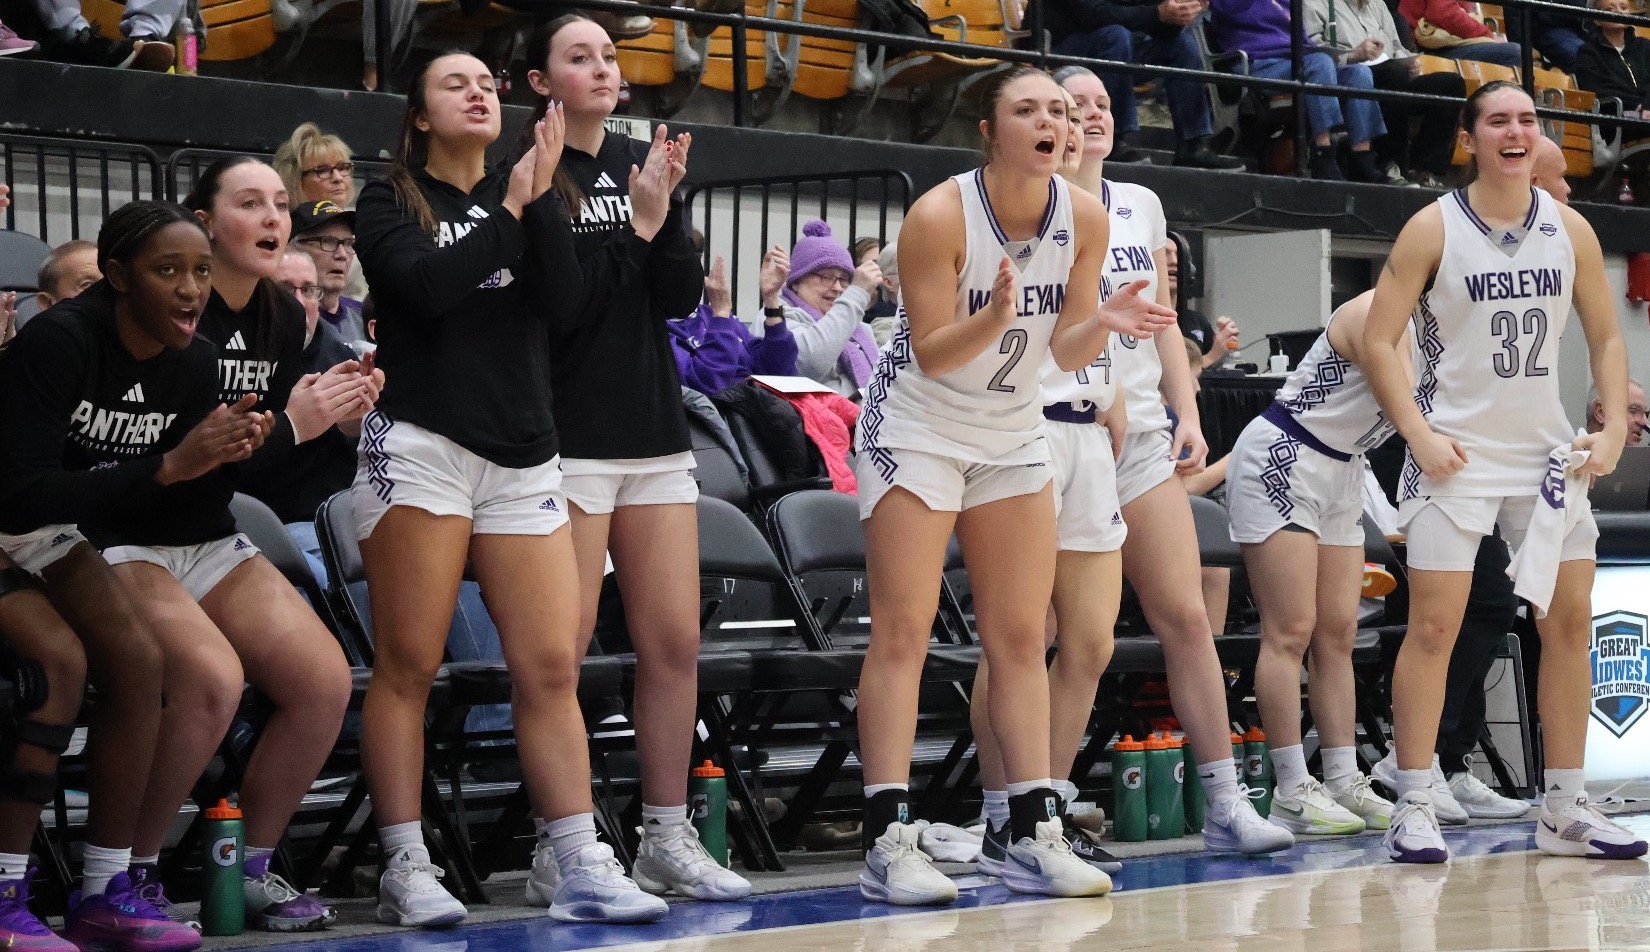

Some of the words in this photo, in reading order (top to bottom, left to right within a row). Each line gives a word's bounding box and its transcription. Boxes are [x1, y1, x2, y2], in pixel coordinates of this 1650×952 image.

[570, 195, 633, 224] ANTH
[969, 283, 1066, 317] WLEYAN
[1464, 268, 1562, 302] WESLEYAN
[1491, 308, 1549, 378] 32
[987, 328, 1028, 393] 2
[1076, 340, 1112, 385] 4
[723, 578, 736, 595] 17
[1600, 637, 1639, 659] GREAT
[1615, 682, 1650, 696] CONFEREN
[1122, 766, 1142, 790] G
[211, 836, 237, 867] G
